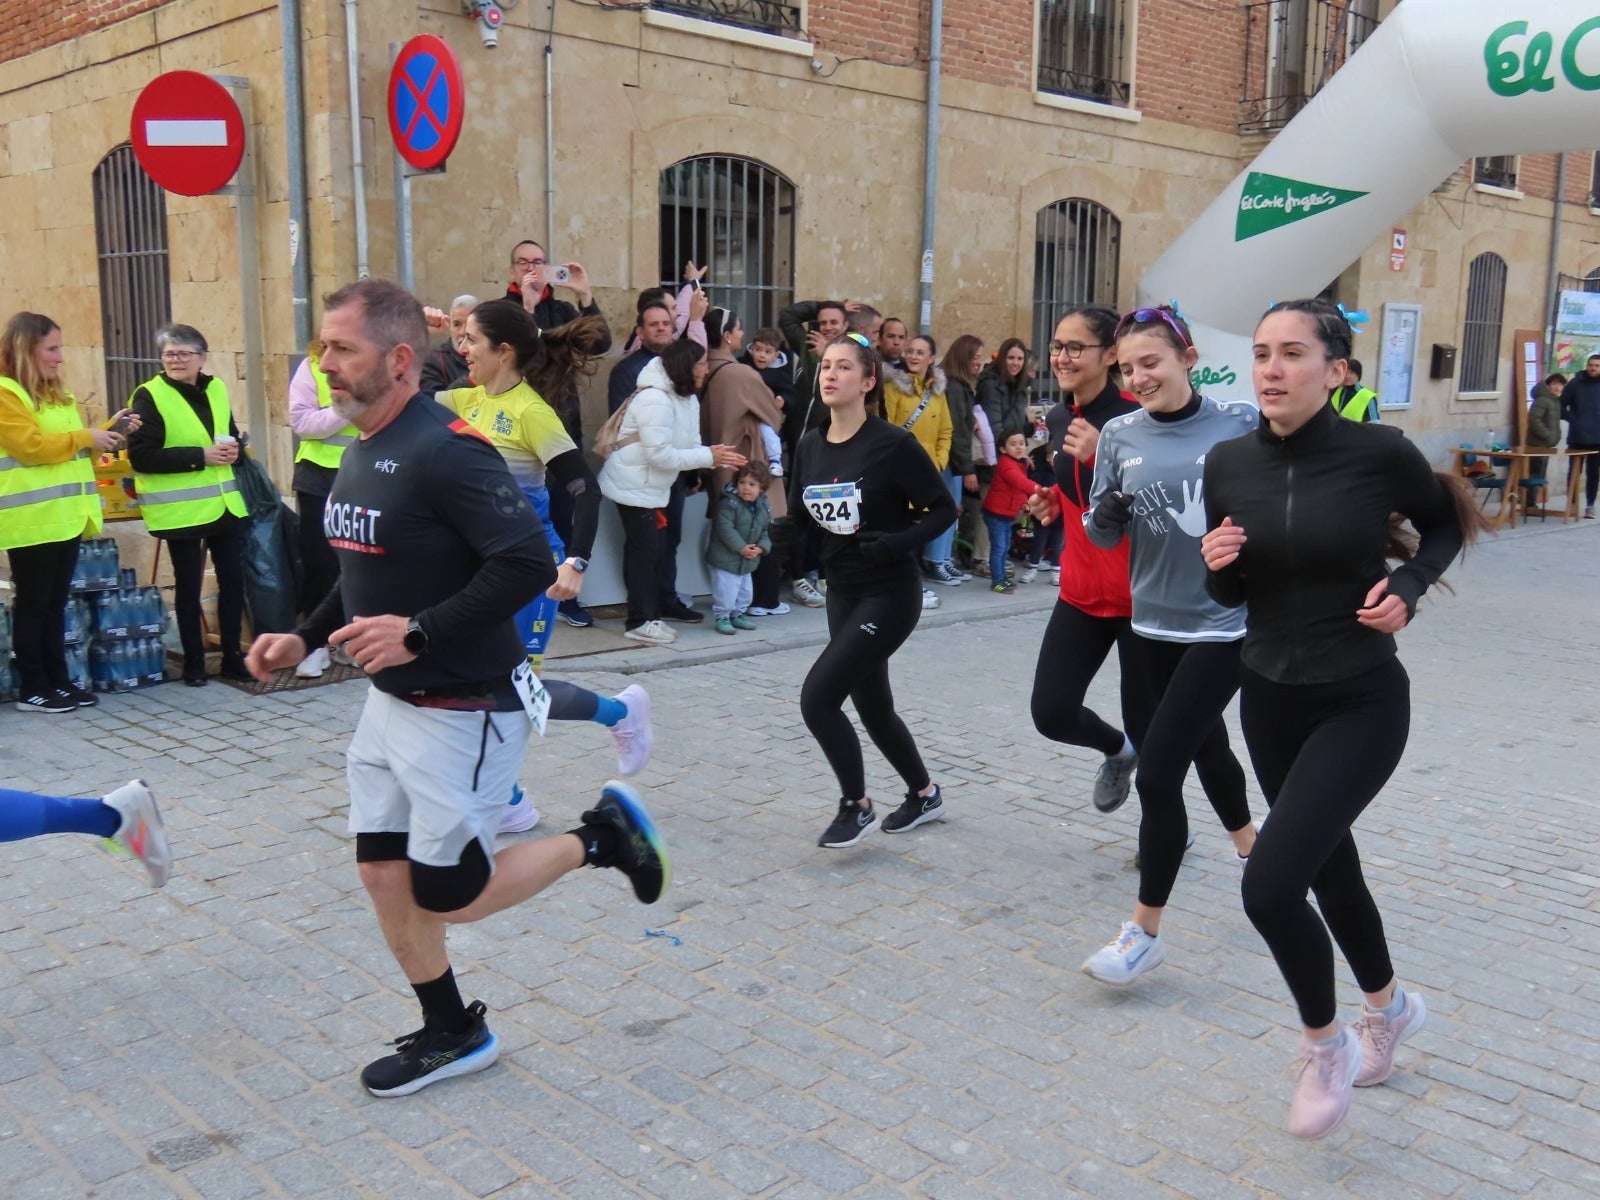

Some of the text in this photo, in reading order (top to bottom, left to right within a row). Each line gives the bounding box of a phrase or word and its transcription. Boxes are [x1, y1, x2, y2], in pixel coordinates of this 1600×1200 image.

[1483, 20, 1555, 97] El
[1241, 195, 1254, 211] El
[1253, 194, 1285, 209] Corte
[1133, 480, 1173, 516] GIVE
[810, 500, 852, 522] 324
[1145, 515, 1169, 536] ME
